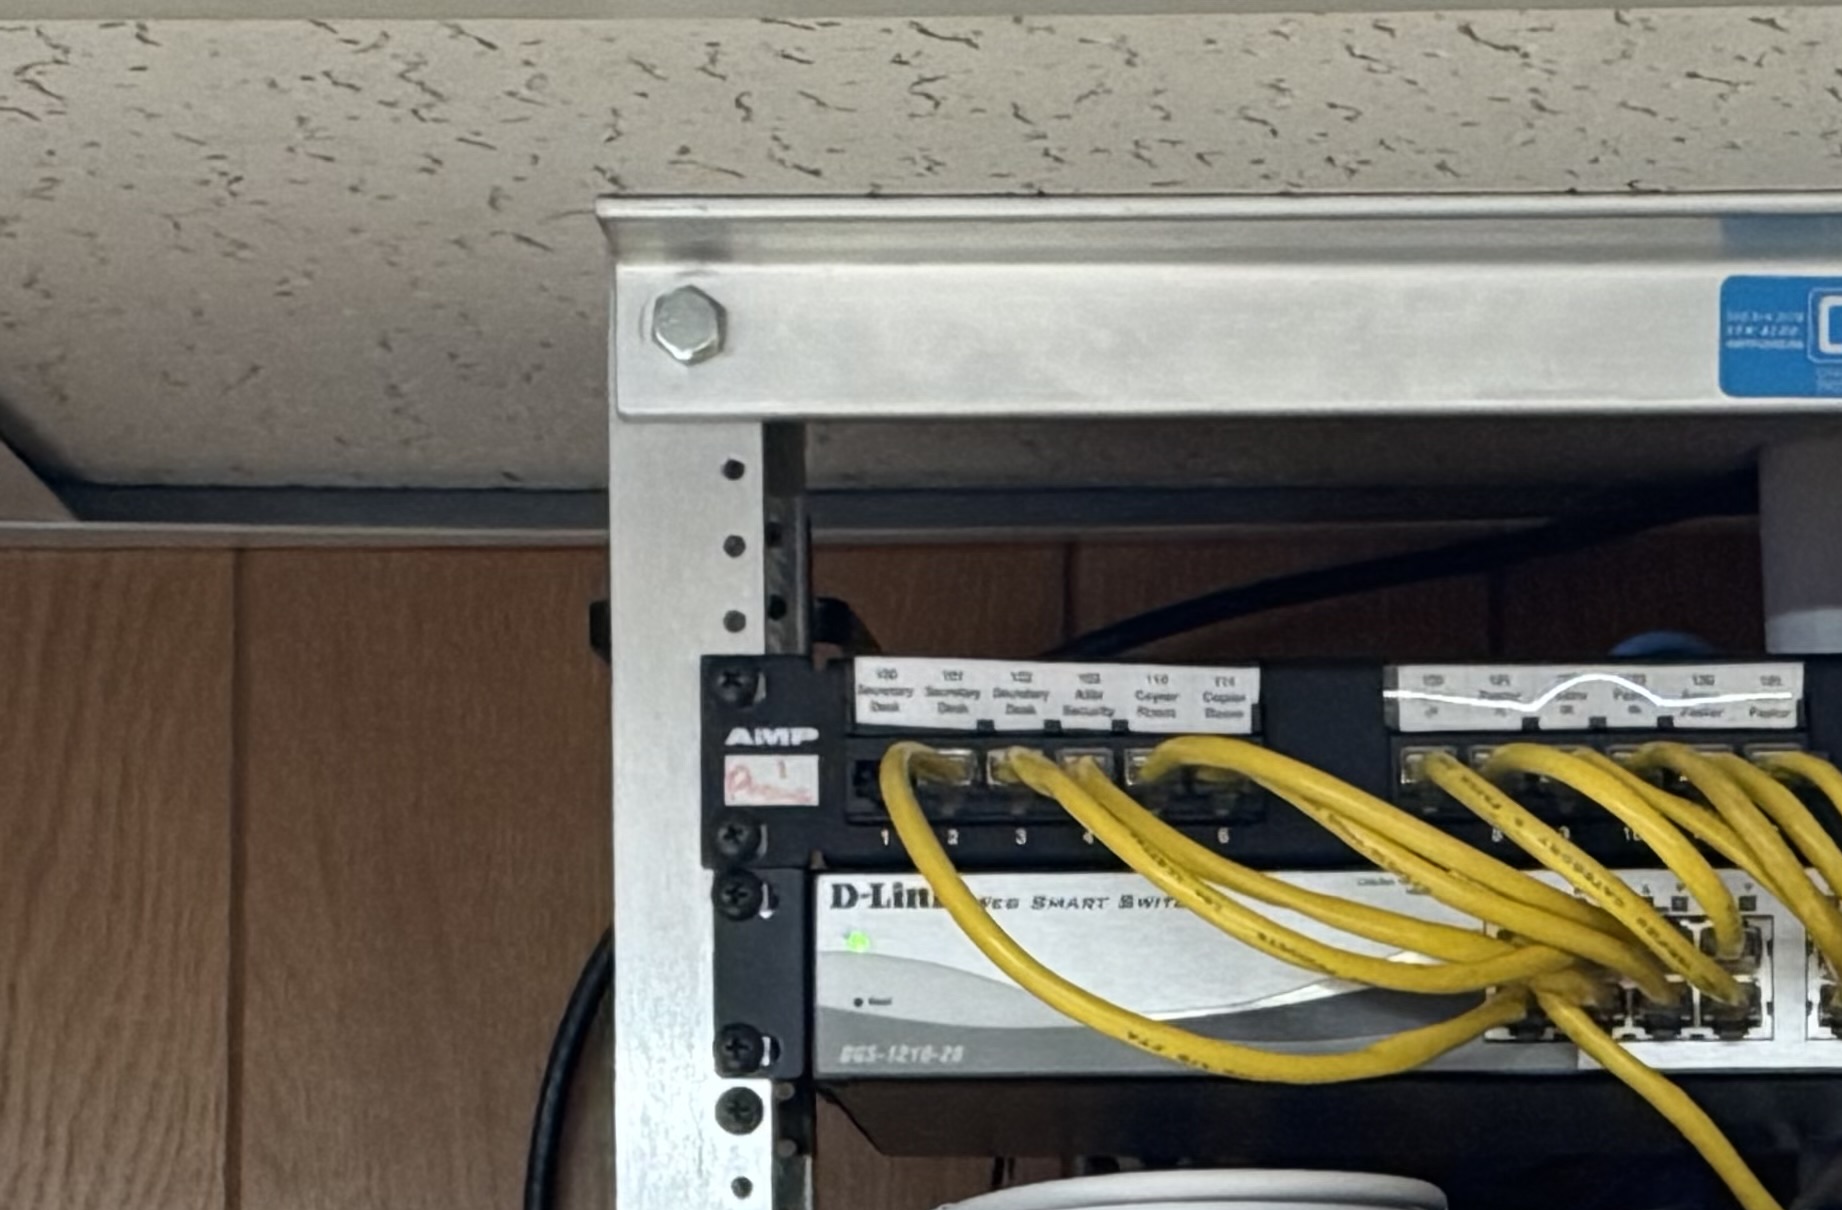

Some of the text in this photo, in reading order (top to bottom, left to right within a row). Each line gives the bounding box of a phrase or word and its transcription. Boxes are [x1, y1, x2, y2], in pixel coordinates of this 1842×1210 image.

[724, 727, 819, 746] AMP
[881, 829, 891, 845] 1
[948, 829, 959, 845] 2
[1015, 829, 1026, 845] 3
